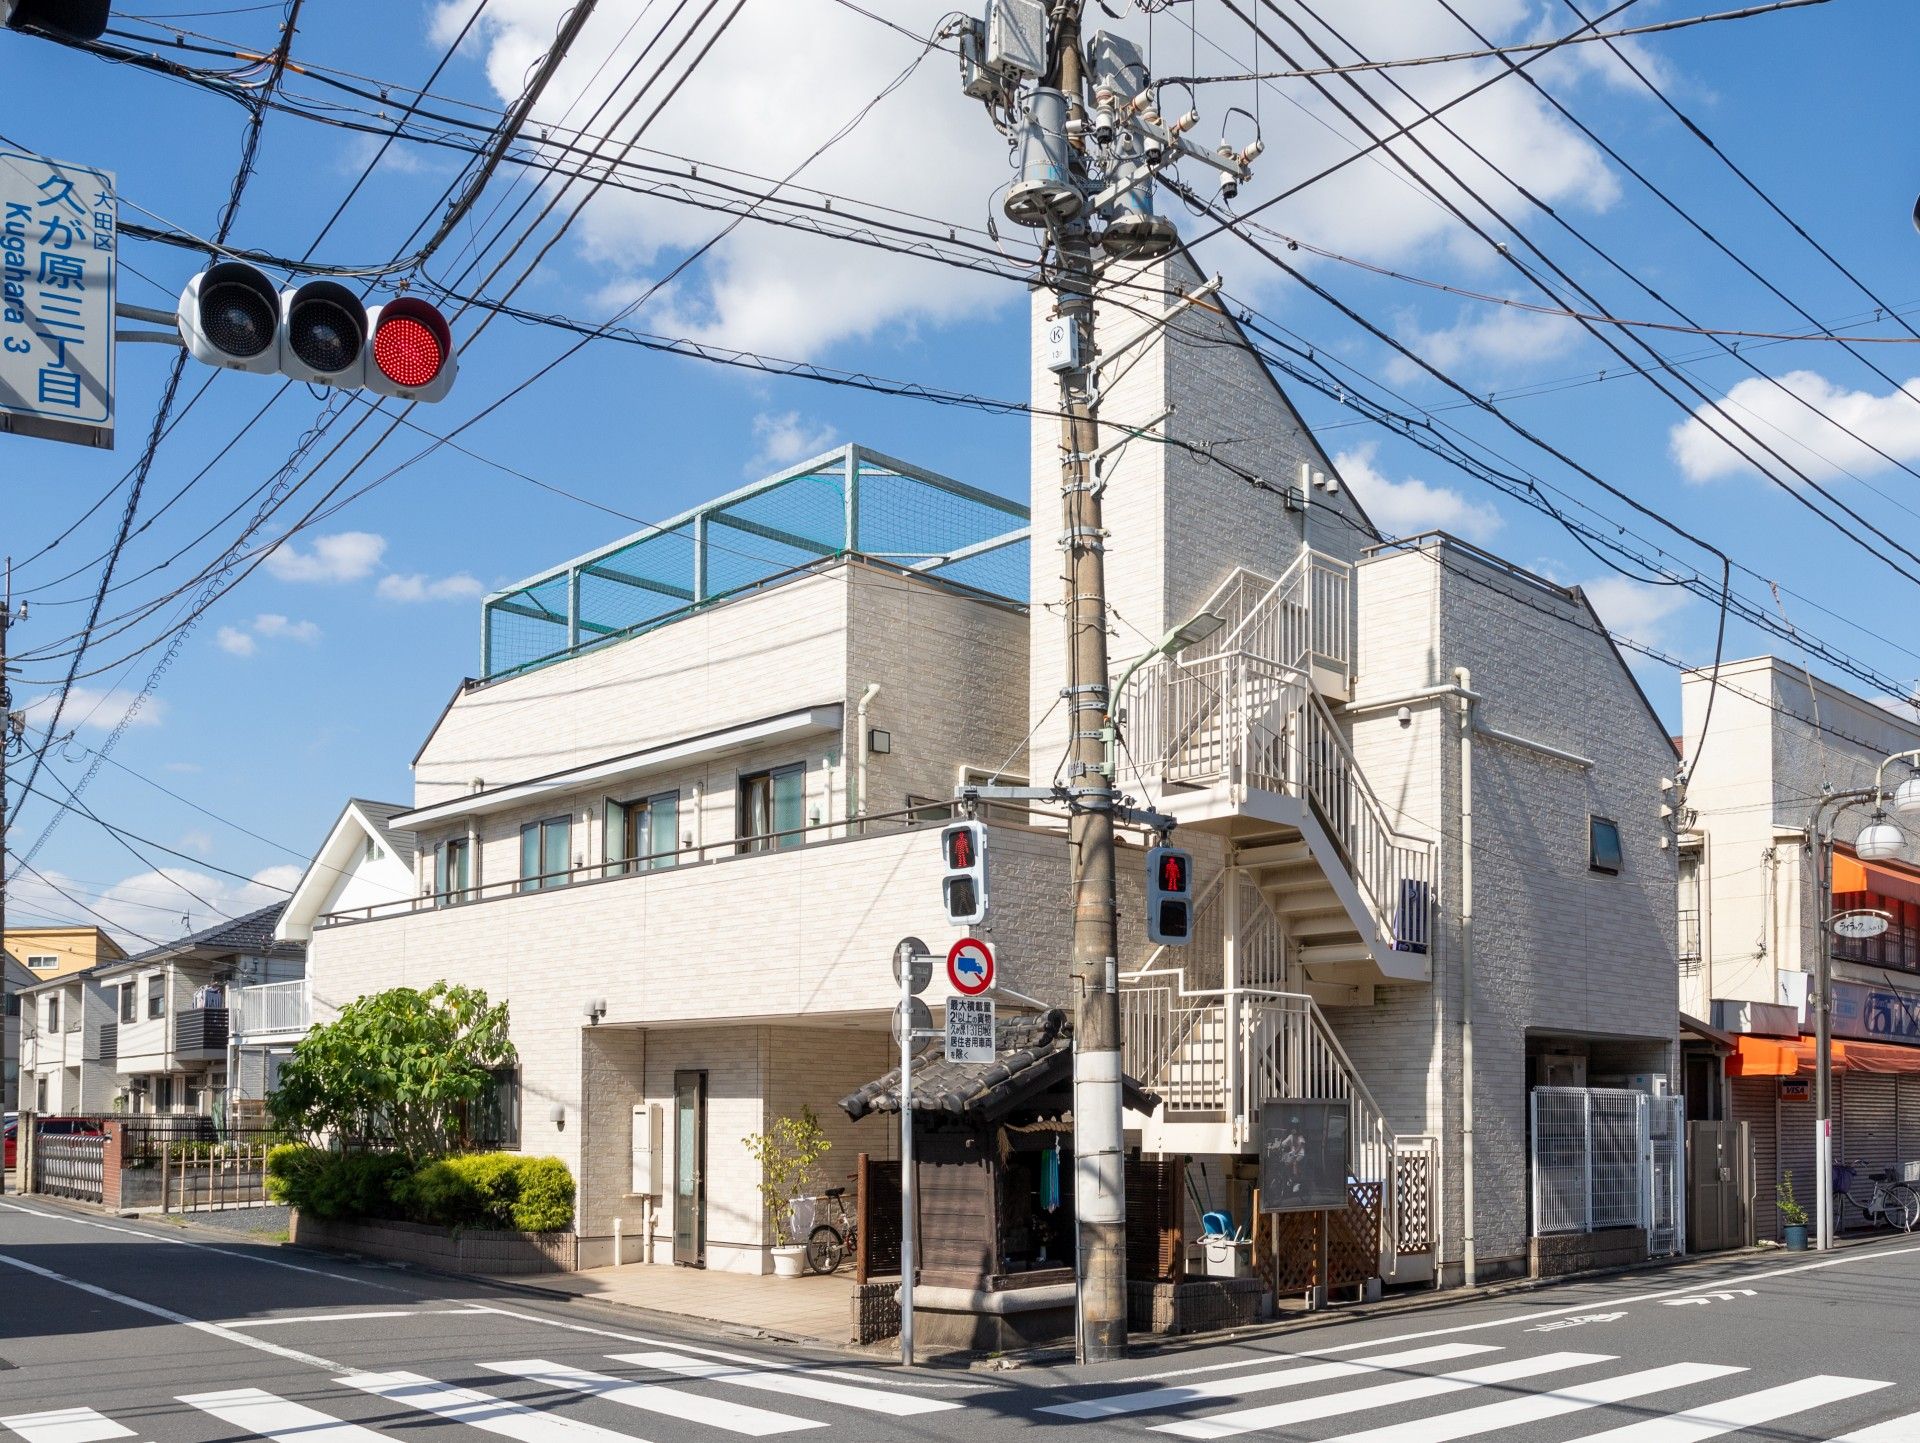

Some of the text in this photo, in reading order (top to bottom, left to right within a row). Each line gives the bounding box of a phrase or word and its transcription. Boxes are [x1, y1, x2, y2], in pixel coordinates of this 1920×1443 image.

[93, 191, 113, 252] 大田区
[0, 202, 32, 354] Kugahara 3
[36, 175, 86, 408] 久が原三丁目
[950, 999, 991, 1012] 最大積載量
[950, 1036, 992, 1048] 居住者用車両
[950, 1048, 969, 1060] を除く
[1786, 1086, 1805, 1094] VISA
